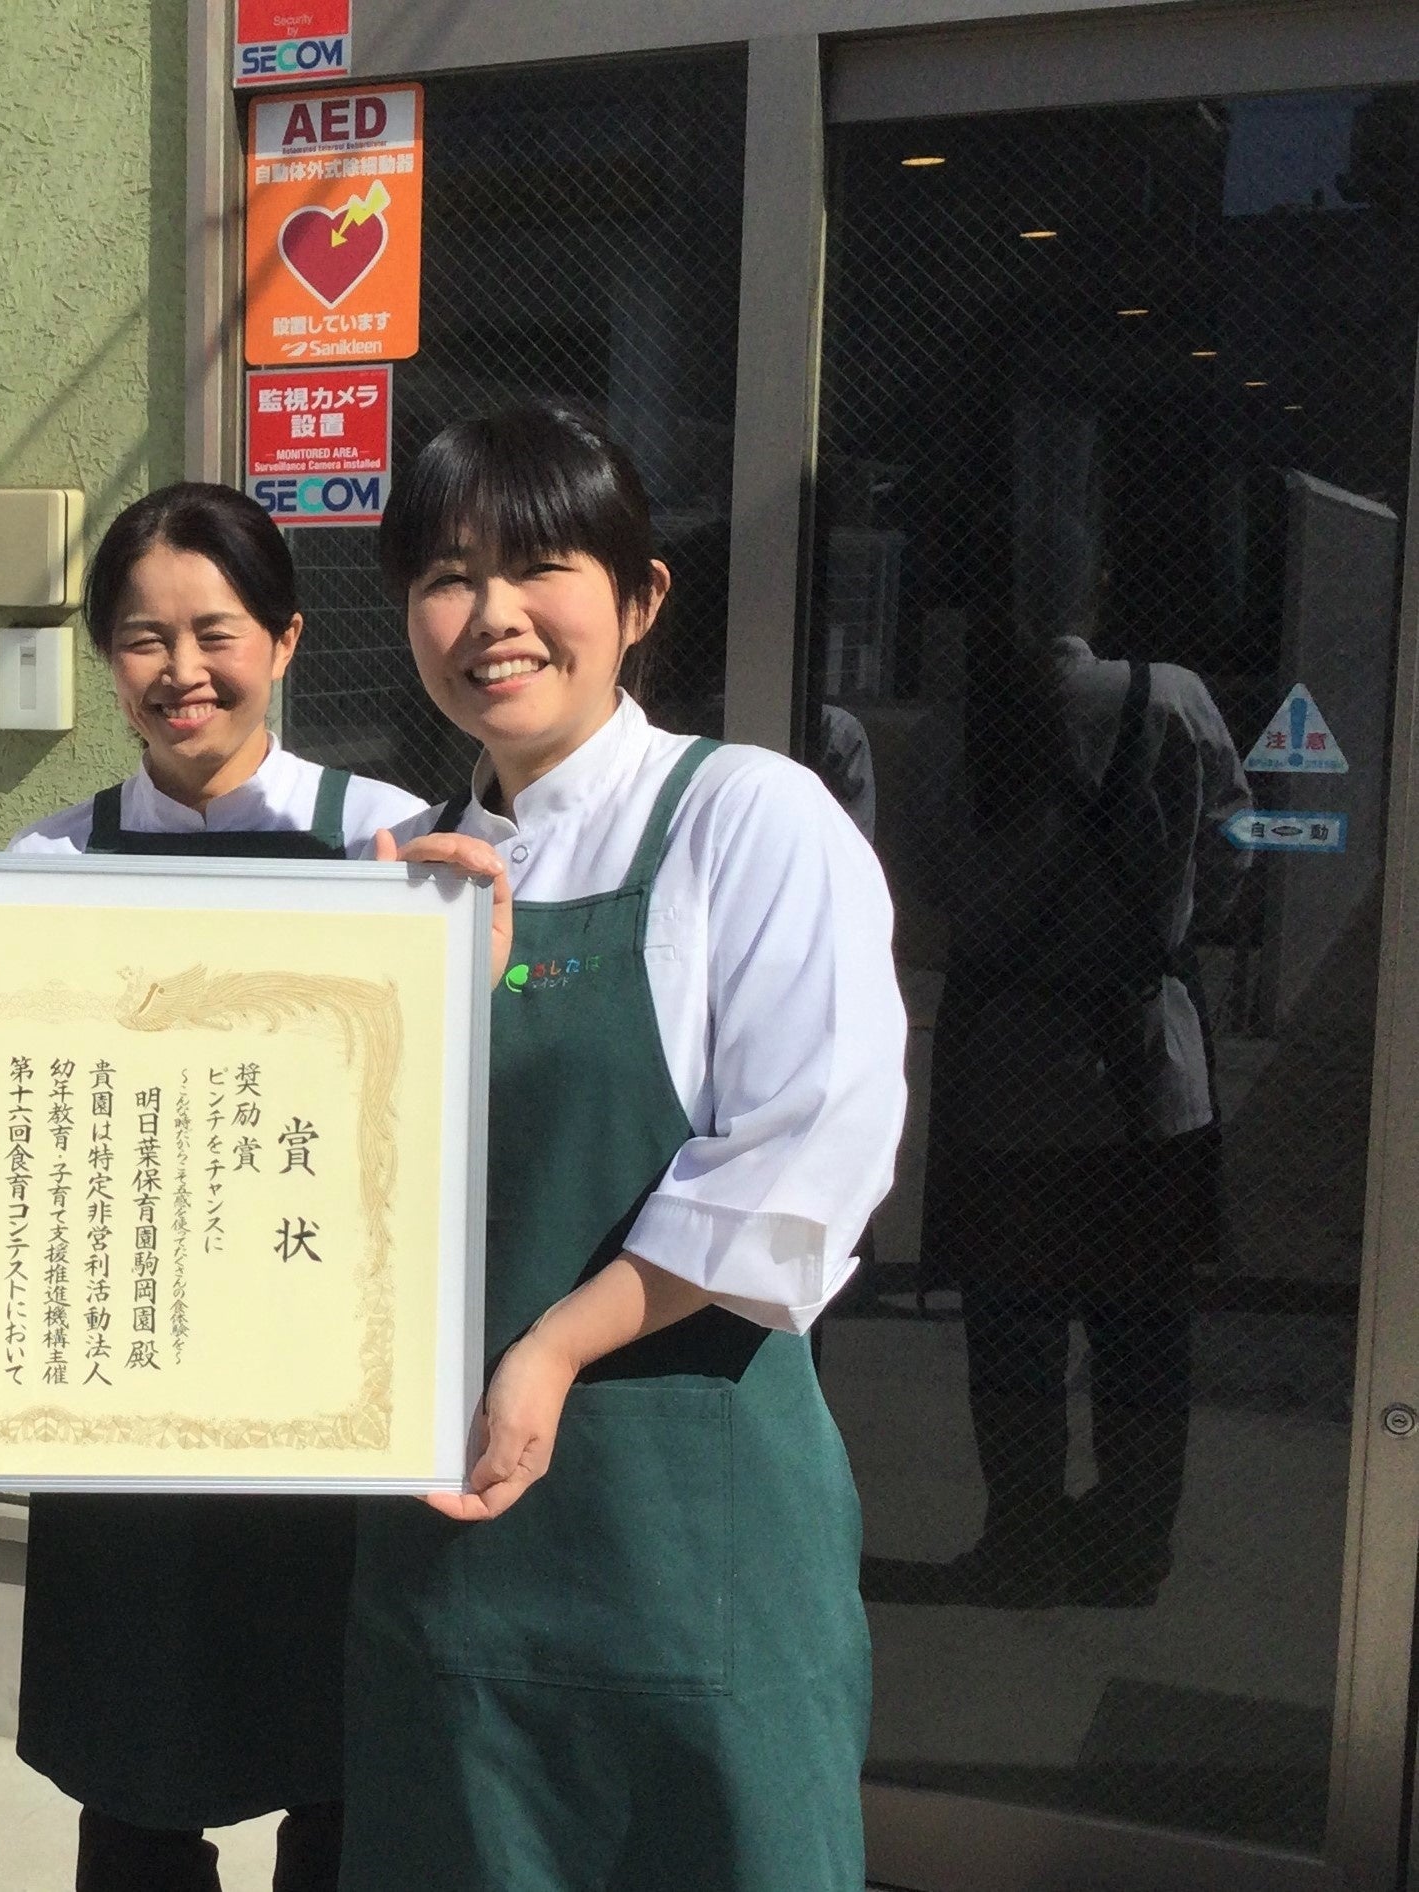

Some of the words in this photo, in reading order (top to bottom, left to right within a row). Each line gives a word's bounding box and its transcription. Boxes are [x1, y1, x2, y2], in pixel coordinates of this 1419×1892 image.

[273, 13, 313, 26] Security
[287, 27, 298, 38] by
[242, 39, 343, 74] SECOM
[282, 96, 387, 145] AED
[273, 312, 391, 336] 設置しています
[310, 339, 382, 357] Sanikleen
[258, 385, 379, 413] 監視カメラ
[291, 412, 344, 438] 設置
[276, 448, 331, 461] MONITORED
[333, 447, 358, 459] AREA
[308, 459, 341, 471] Camera
[255, 477, 380, 513] SECOM
[1250, 821, 1329, 842] 自動
[232, 1062, 262, 1174] 奨励賞
[203, 1067, 229, 1254] ピンチをチャンスに
[274, 1116, 322, 1263] 賞状
[4, 1055, 35, 1386] 第十六回食育コンテストにおいて
[42, 1057, 76, 1385] 幼年教育・子育て支援推進機構主催
[82, 1058, 117, 1387] 貴園は特定非営利活動法人
